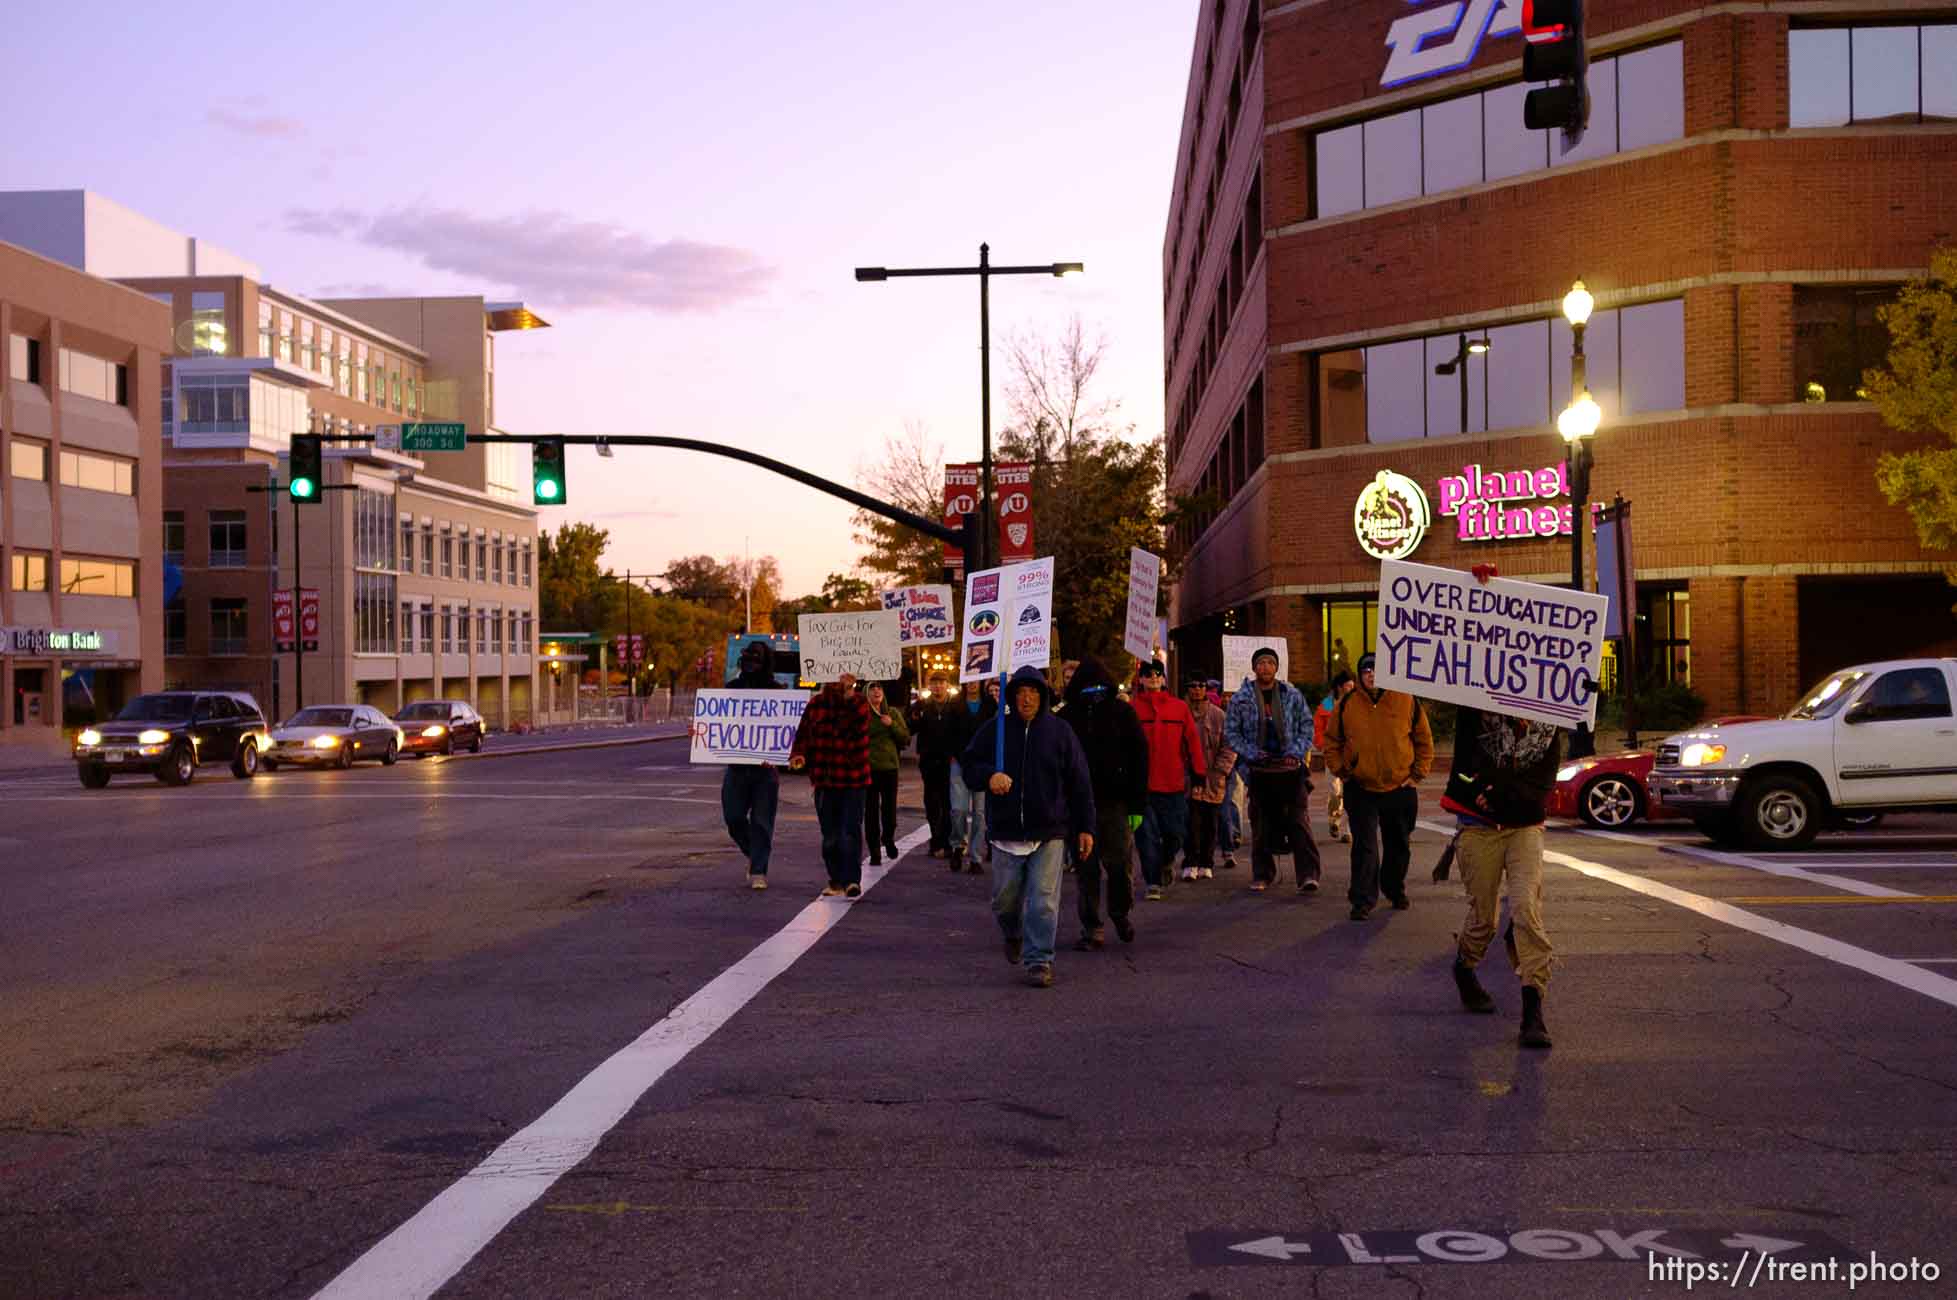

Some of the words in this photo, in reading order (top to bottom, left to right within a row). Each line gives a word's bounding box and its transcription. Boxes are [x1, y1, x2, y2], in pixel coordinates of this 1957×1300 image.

[998, 472, 1029, 484] UTES
[1438, 459, 1572, 515] planet
[1362, 516, 1402, 531] planet
[1017, 579, 1050, 591] STRONG
[1018, 569, 1049, 585] 99%
[1392, 576, 1463, 611] OVER
[1467, 588, 1599, 636] EDUCATED?
[17, 631, 69, 652] Brighton
[72, 631, 100, 649] Bank
[1014, 635, 1046, 650] 99%
[1384, 604, 1457, 638] UNDER
[1463, 619, 1593, 664] EMPLOYED?
[1013, 646, 1047, 657] STRONG
[1530, 657, 1594, 706] TOO
[741, 698, 778, 716] FEAR
[781, 699, 808, 716] THE
[1338, 1229, 1704, 1264] LOOK
